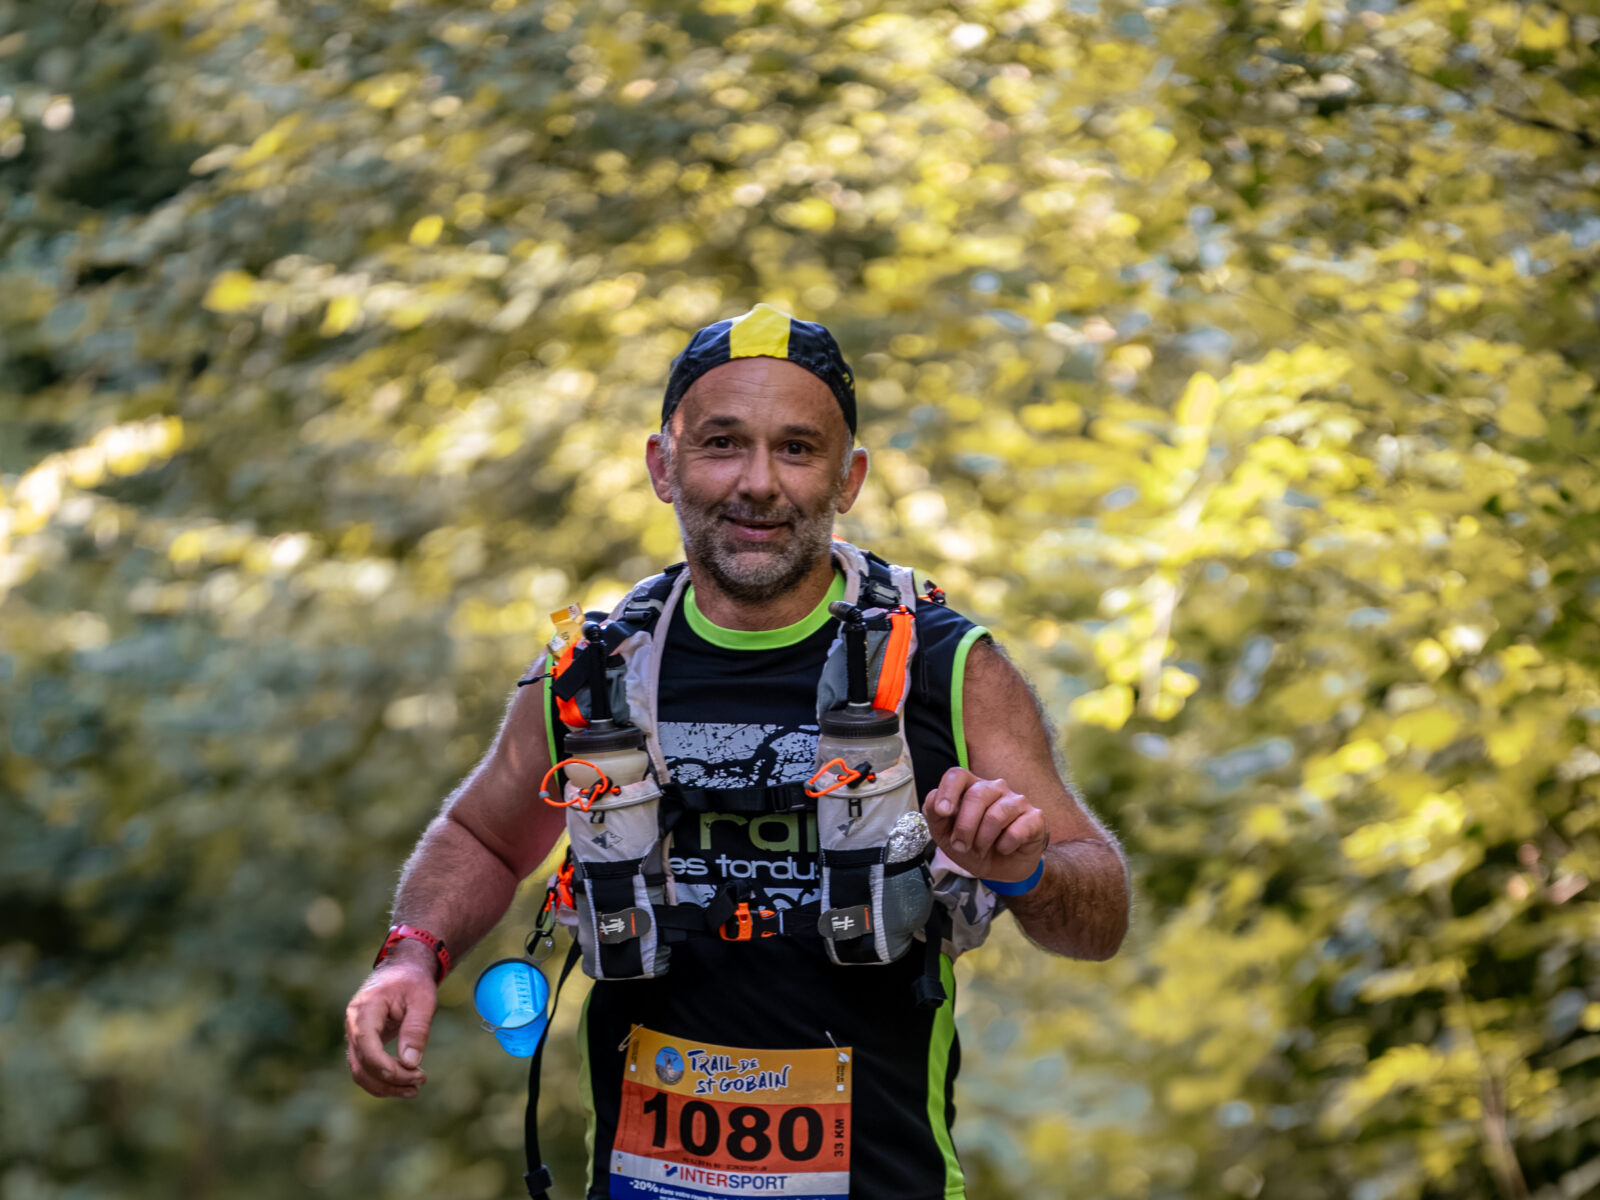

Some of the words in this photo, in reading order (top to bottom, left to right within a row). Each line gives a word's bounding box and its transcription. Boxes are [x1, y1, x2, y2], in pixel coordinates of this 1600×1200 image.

[669, 857, 709, 876] es
[687, 1049, 738, 1076] TRAIL
[739, 1058, 759, 1073] DE
[719, 1065, 791, 1092] GOBAIN
[643, 1092, 824, 1162] 1080
[834, 1118, 844, 1138] KM
[834, 1142, 844, 1157] 33
[629, 1179, 659, 1193] -20%
[680, 1166, 788, 1190] INTERSPORT
